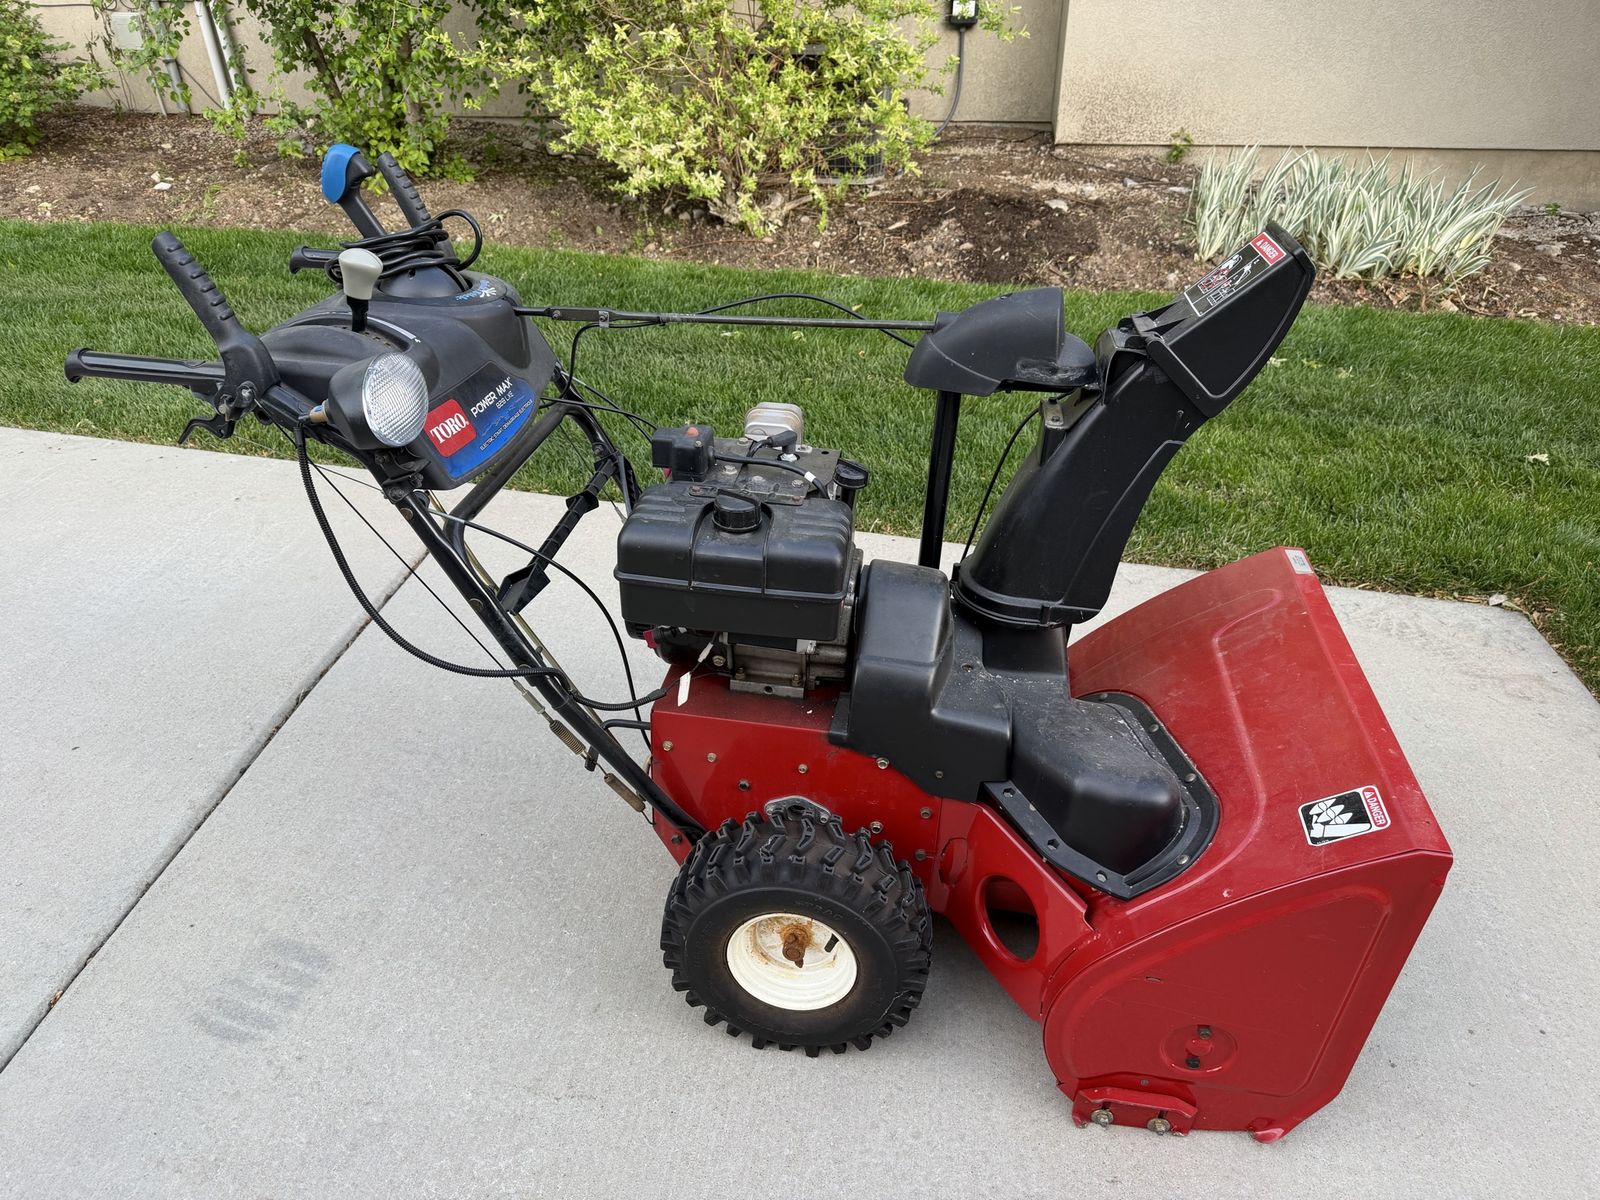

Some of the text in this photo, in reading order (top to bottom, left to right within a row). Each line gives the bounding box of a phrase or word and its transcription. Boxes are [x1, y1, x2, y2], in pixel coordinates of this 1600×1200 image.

[470, 378, 513, 418] POWER MAX
[430, 413, 469, 444] TORO
[1367, 797, 1386, 826] DANGER
